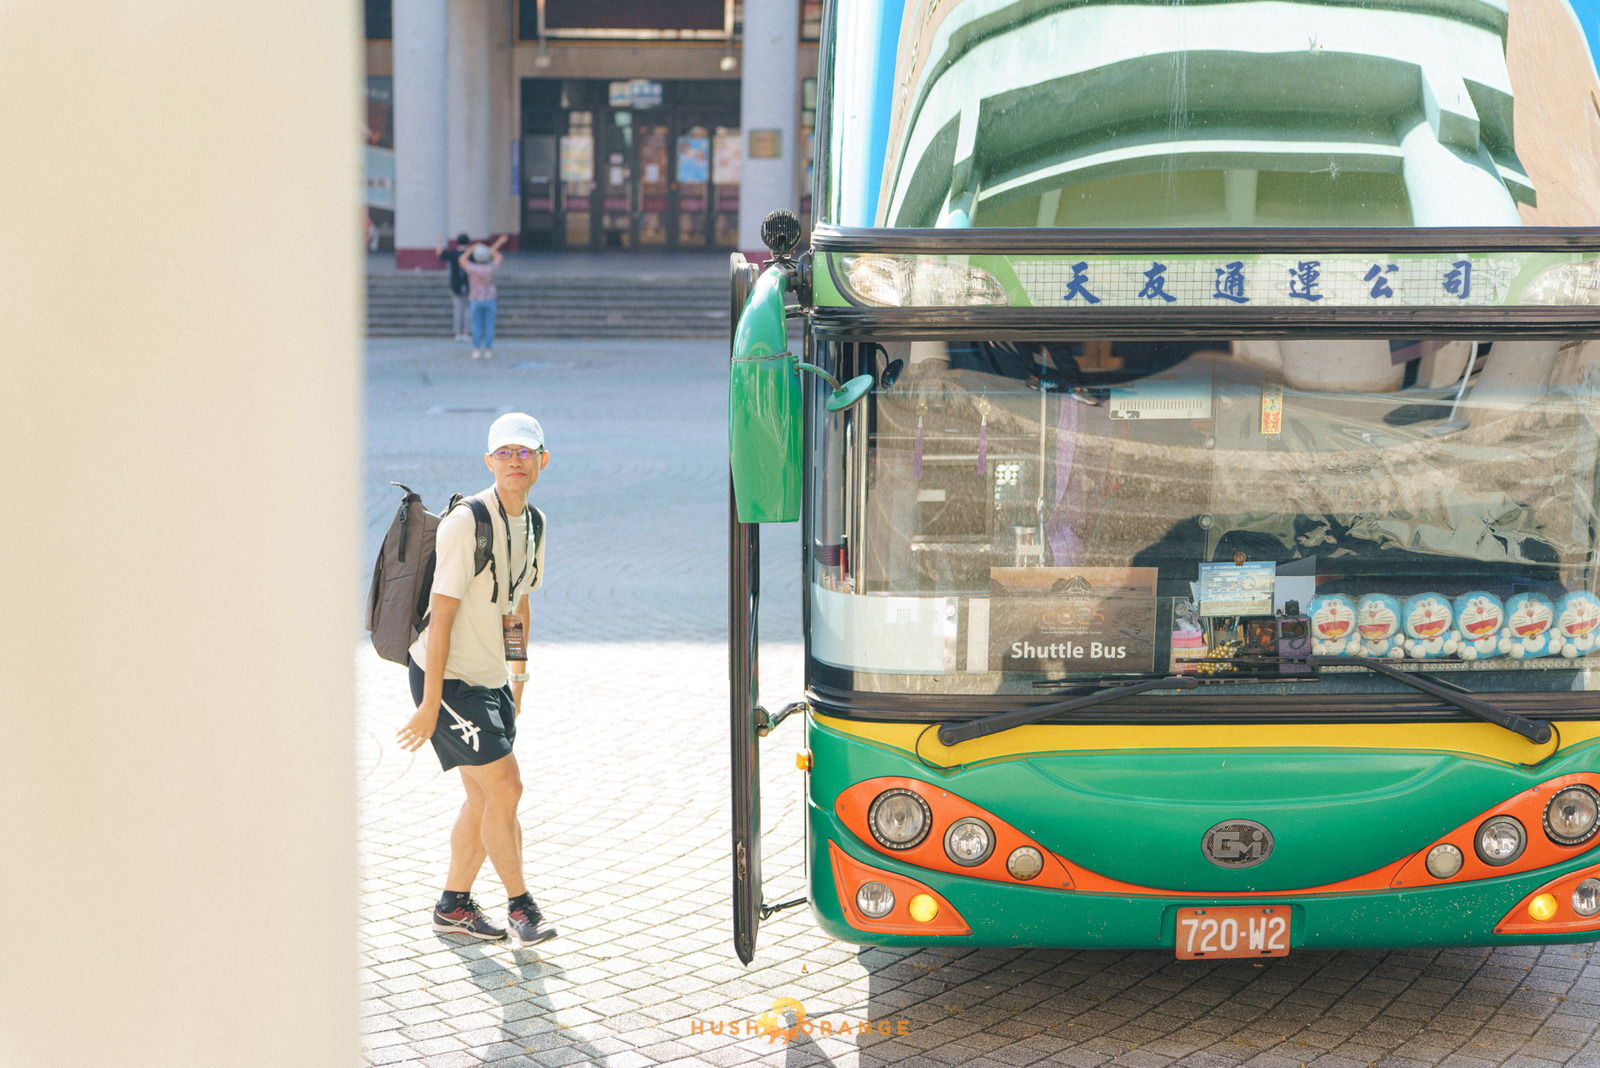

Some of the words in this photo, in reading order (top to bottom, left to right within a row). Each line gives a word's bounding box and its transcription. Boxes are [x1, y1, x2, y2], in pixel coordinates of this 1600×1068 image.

[1011, 641, 1085, 659] Shuttle
[1090, 642, 1127, 659] Bus
[1181, 916, 1287, 953] 720-W2
